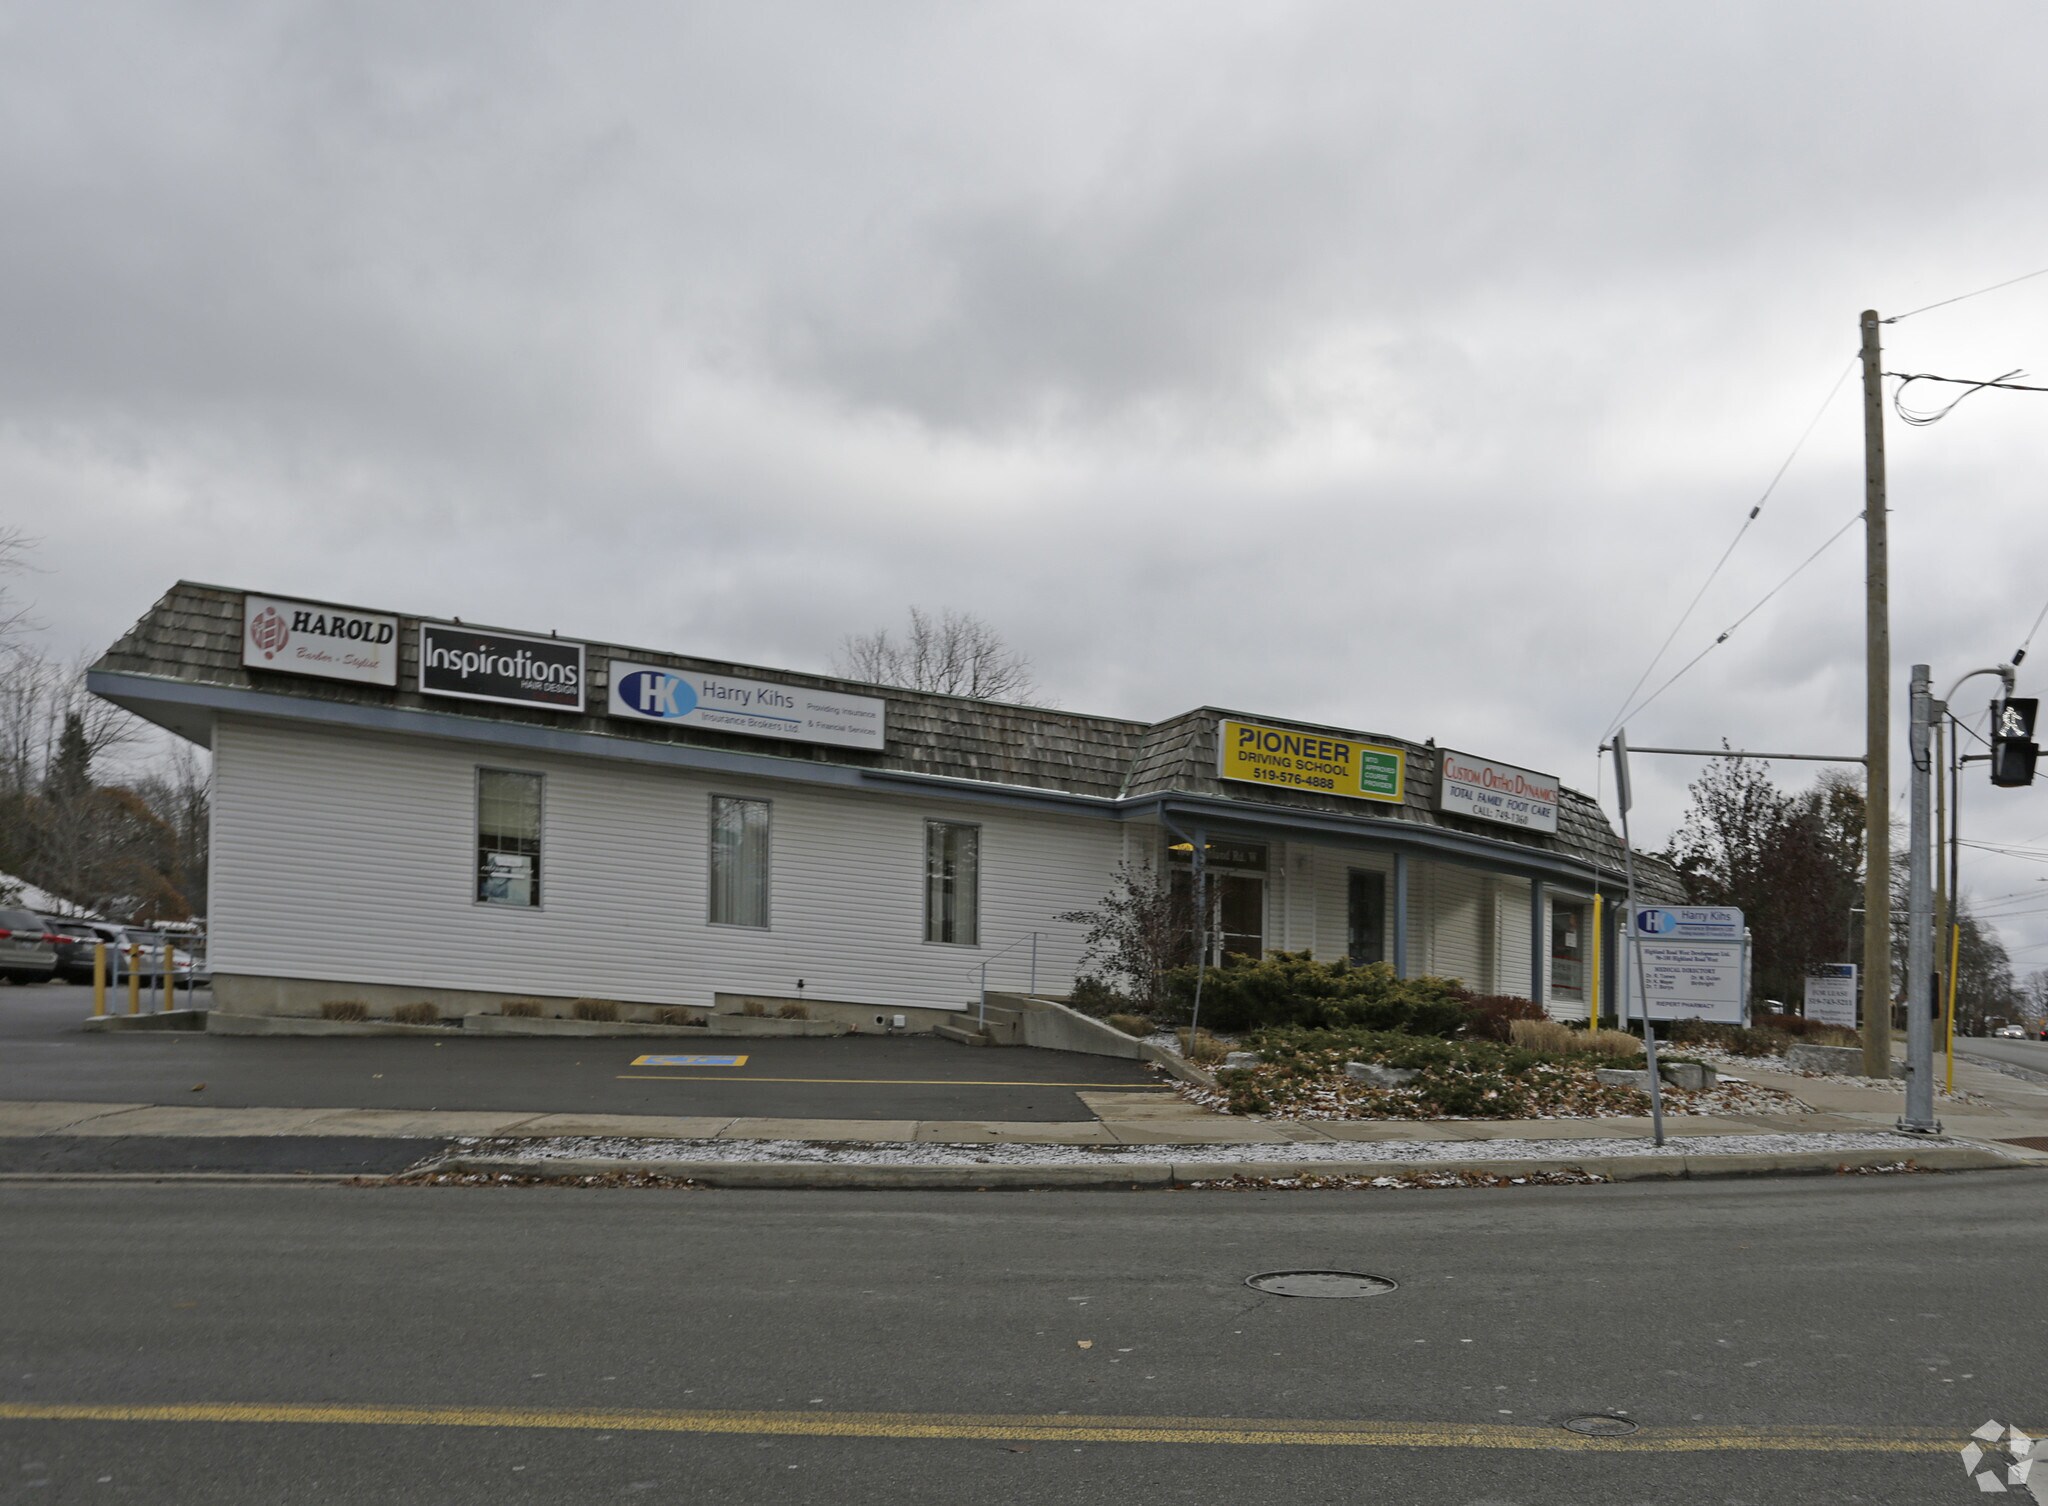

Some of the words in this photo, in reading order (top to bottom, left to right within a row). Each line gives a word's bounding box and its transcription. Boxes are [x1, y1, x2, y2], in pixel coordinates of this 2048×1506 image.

[291, 611, 393, 645] HAROLD
[426, 636, 578, 686] Inspirations
[521, 680, 542, 691] HAIR
[544, 682, 577, 695] DESIGN
[703, 680, 751, 706] Harry
[757, 688, 794, 709] Kihs
[807, 702, 840, 716] Providing
[842, 708, 876, 719] Insurance
[701, 712, 746, 727] Insurance
[747, 718, 783, 732] Brokers
[815, 721, 846, 732] Financial
[848, 725, 877, 736] Services
[1239, 727, 1350, 764] PIONEER
[1239, 750, 1292, 768] DRIVING
[1295, 759, 1349, 777] SCHOOL
[1365, 764, 1396, 775] APPROVED
[1253, 768, 1334, 790] 519-576-4888
[1364, 772, 1389, 781] COURSE
[1364, 779, 1393, 789] PROVIDER
[1450, 785, 1474, 801] TOTAL
[1477, 792, 1504, 807] FAMILY
[1507, 799, 1529, 813] FOOT
[1531, 804, 1551, 818] CARE
[1472, 804, 1493, 818] CALL:
[1681, 910, 1708, 922] Harry
[1710, 911, 1732, 921] Kihs
